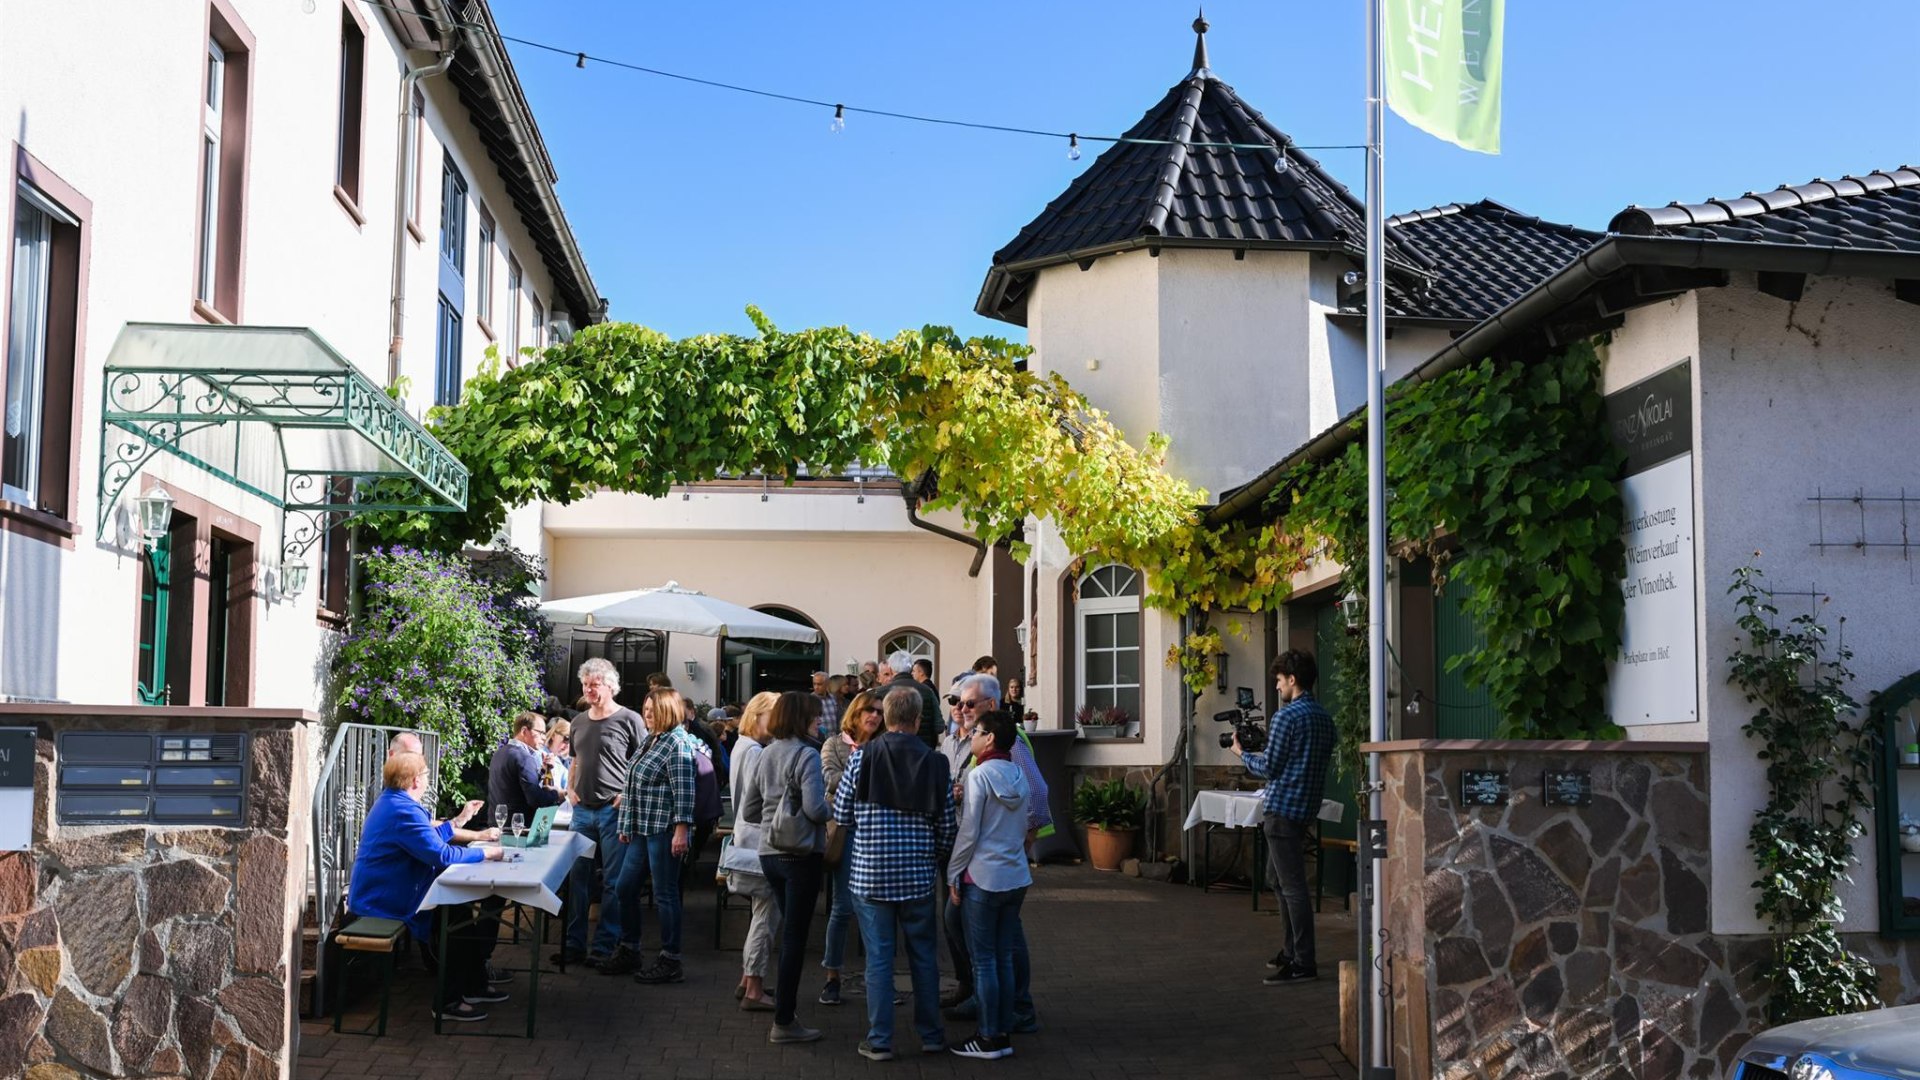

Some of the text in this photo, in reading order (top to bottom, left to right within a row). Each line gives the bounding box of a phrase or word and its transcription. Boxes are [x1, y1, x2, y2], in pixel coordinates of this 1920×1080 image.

[1400, 0, 1442, 92] HE
[1619, 507, 1676, 535] einverkostung
[1627, 534, 1679, 565] Weinverkauf
[1639, 571, 1677, 596] Vinothek.
